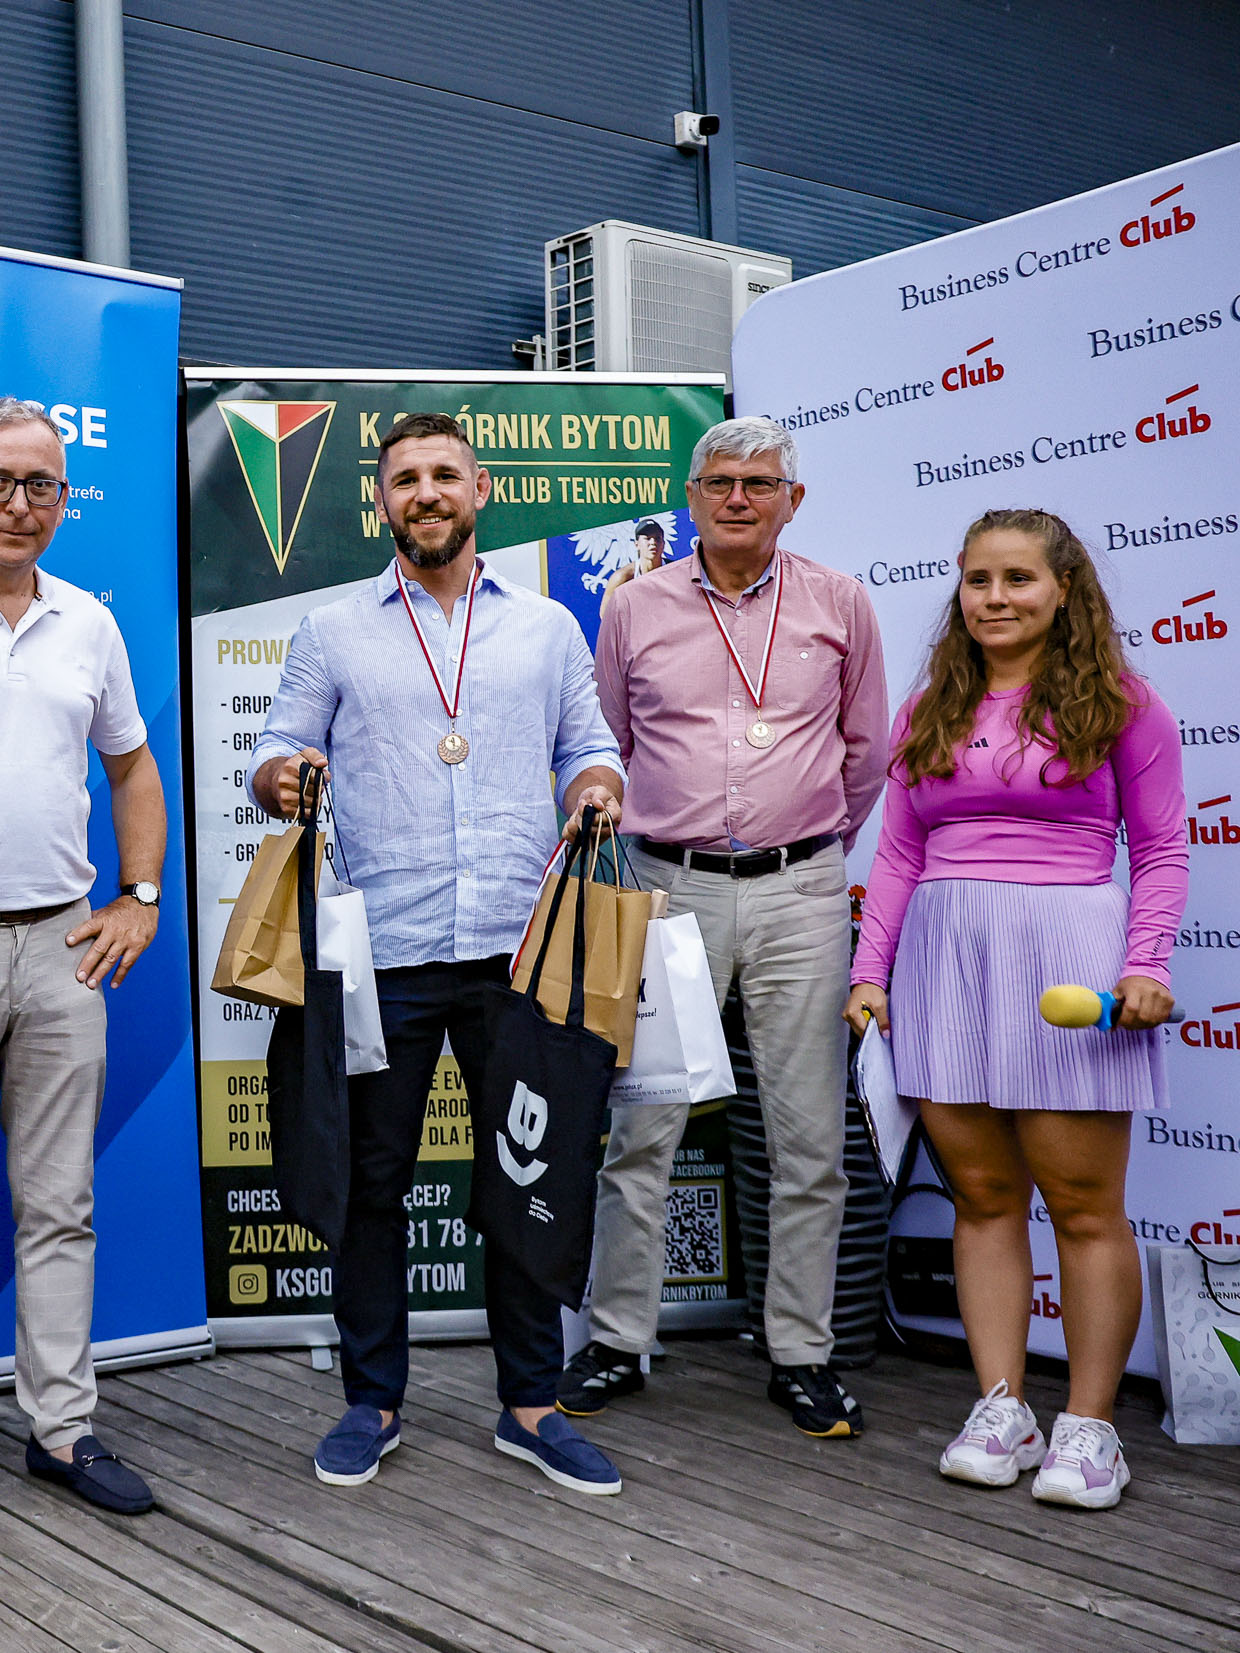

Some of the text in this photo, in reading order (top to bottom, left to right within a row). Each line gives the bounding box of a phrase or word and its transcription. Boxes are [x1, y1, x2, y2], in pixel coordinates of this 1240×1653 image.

[898, 205, 1196, 311] Business Centre Club
[1087, 309, 1223, 358] Business
[855, 380, 935, 412] Centre
[941, 357, 1004, 392] Club
[440, 405, 552, 450] ÓRNIK
[561, 414, 671, 450] BYTOM
[913, 406, 1212, 488] Business Centre Club
[493, 476, 670, 504] KLUB TENISOWY
[1103, 514, 1239, 551] Business
[869, 559, 950, 586] Centre
[1152, 612, 1228, 645] Club
[1184, 816, 1240, 845] lub
[223, 1003, 263, 1021] ORAZ
[228, 1104, 249, 1123] OD
[229, 1131, 250, 1151] PO
[429, 1126, 460, 1146] DLA
[1144, 1115, 1240, 1154] Busin
[437, 1218, 466, 1247] 78
